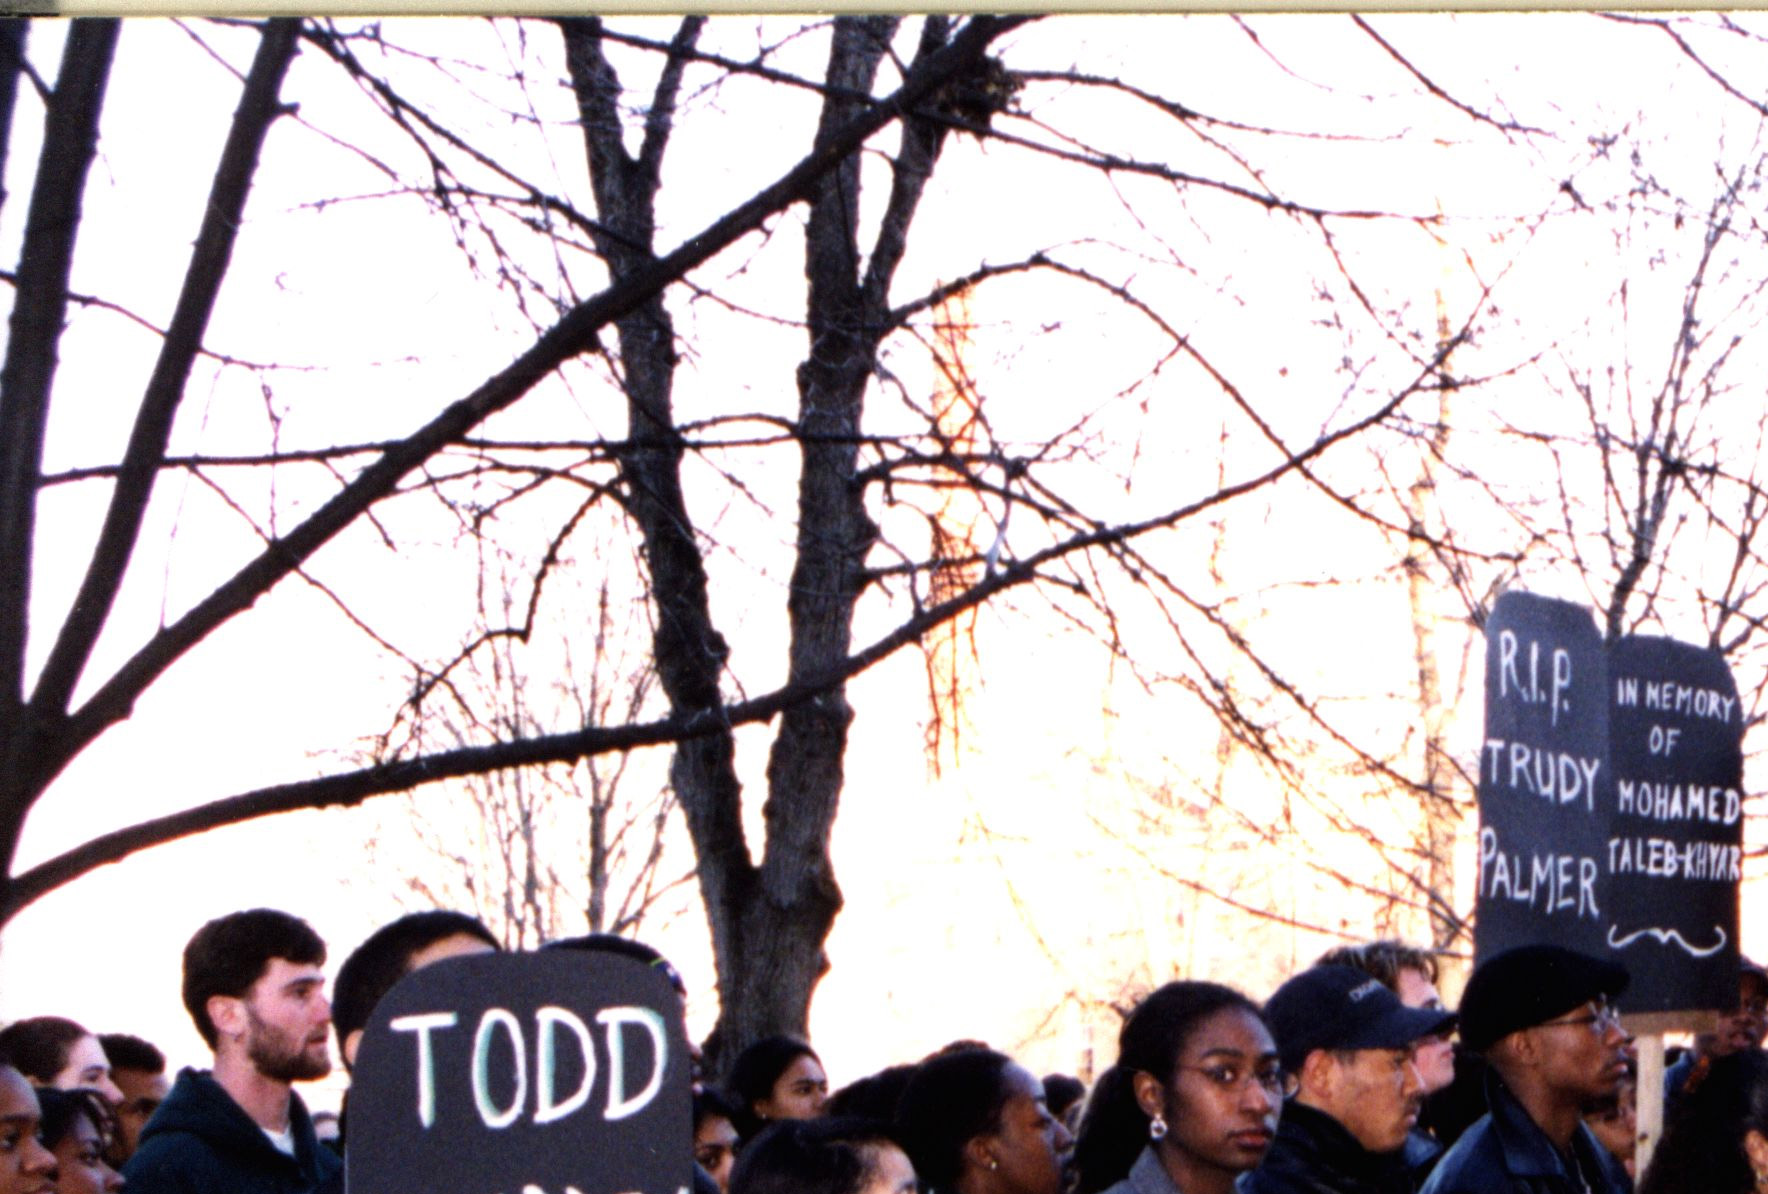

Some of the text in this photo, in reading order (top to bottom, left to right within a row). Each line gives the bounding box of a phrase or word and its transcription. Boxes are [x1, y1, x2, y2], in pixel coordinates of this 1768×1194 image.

[1499, 629, 1572, 726] R.I.P.
[1617, 678, 1735, 723] IN MEMORY
[1487, 740, 1600, 810] TRUDY
[1649, 725, 1680, 757] OF
[1618, 779, 1739, 826] MOHAMED
[1479, 826, 1599, 919] PALMER
[391, 1006, 669, 1128] TODD
